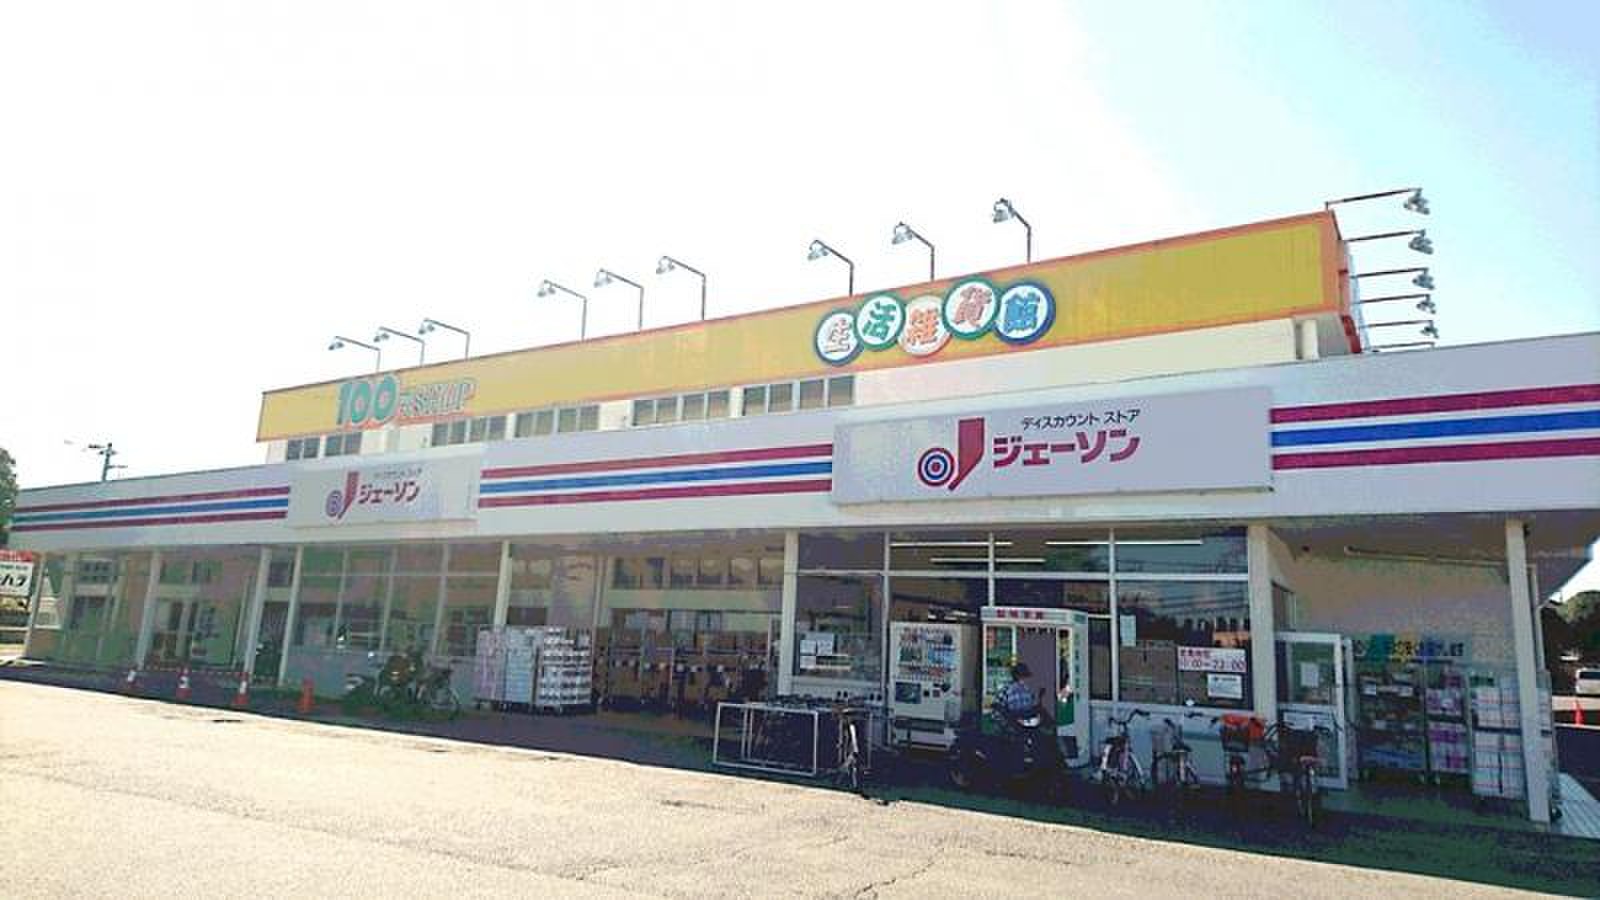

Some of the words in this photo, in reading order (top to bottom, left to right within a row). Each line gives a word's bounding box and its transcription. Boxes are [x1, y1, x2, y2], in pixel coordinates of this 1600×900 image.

[1022, 412, 1099, 430] ディスカウント
[1104, 409, 1140, 424] ストア
[993, 429, 1140, 468] ジェーソン
[358, 481, 420, 504] ジェーソン
